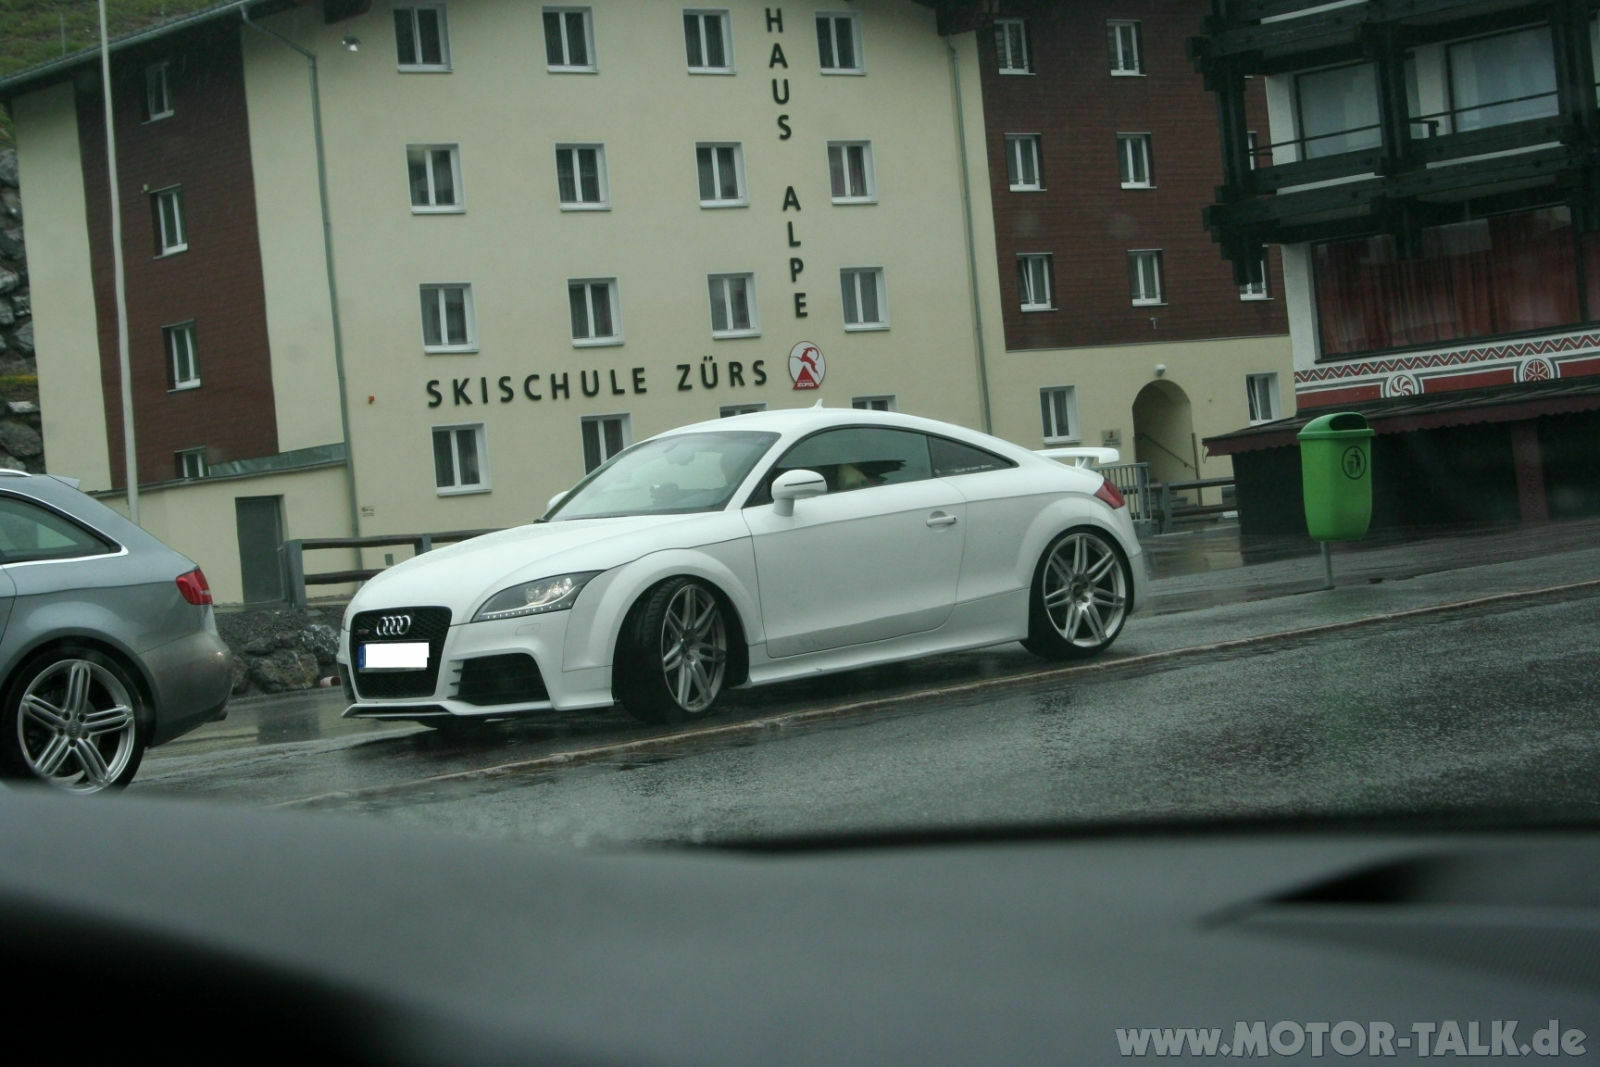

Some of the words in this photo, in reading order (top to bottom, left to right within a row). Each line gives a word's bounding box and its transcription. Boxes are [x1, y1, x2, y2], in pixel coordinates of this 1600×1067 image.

[765, 7, 792, 141] HAUS
[782, 185, 808, 319] ALPE
[426, 367, 648, 409] SKISCHULE
[676, 355, 767, 392] ZÜRS
